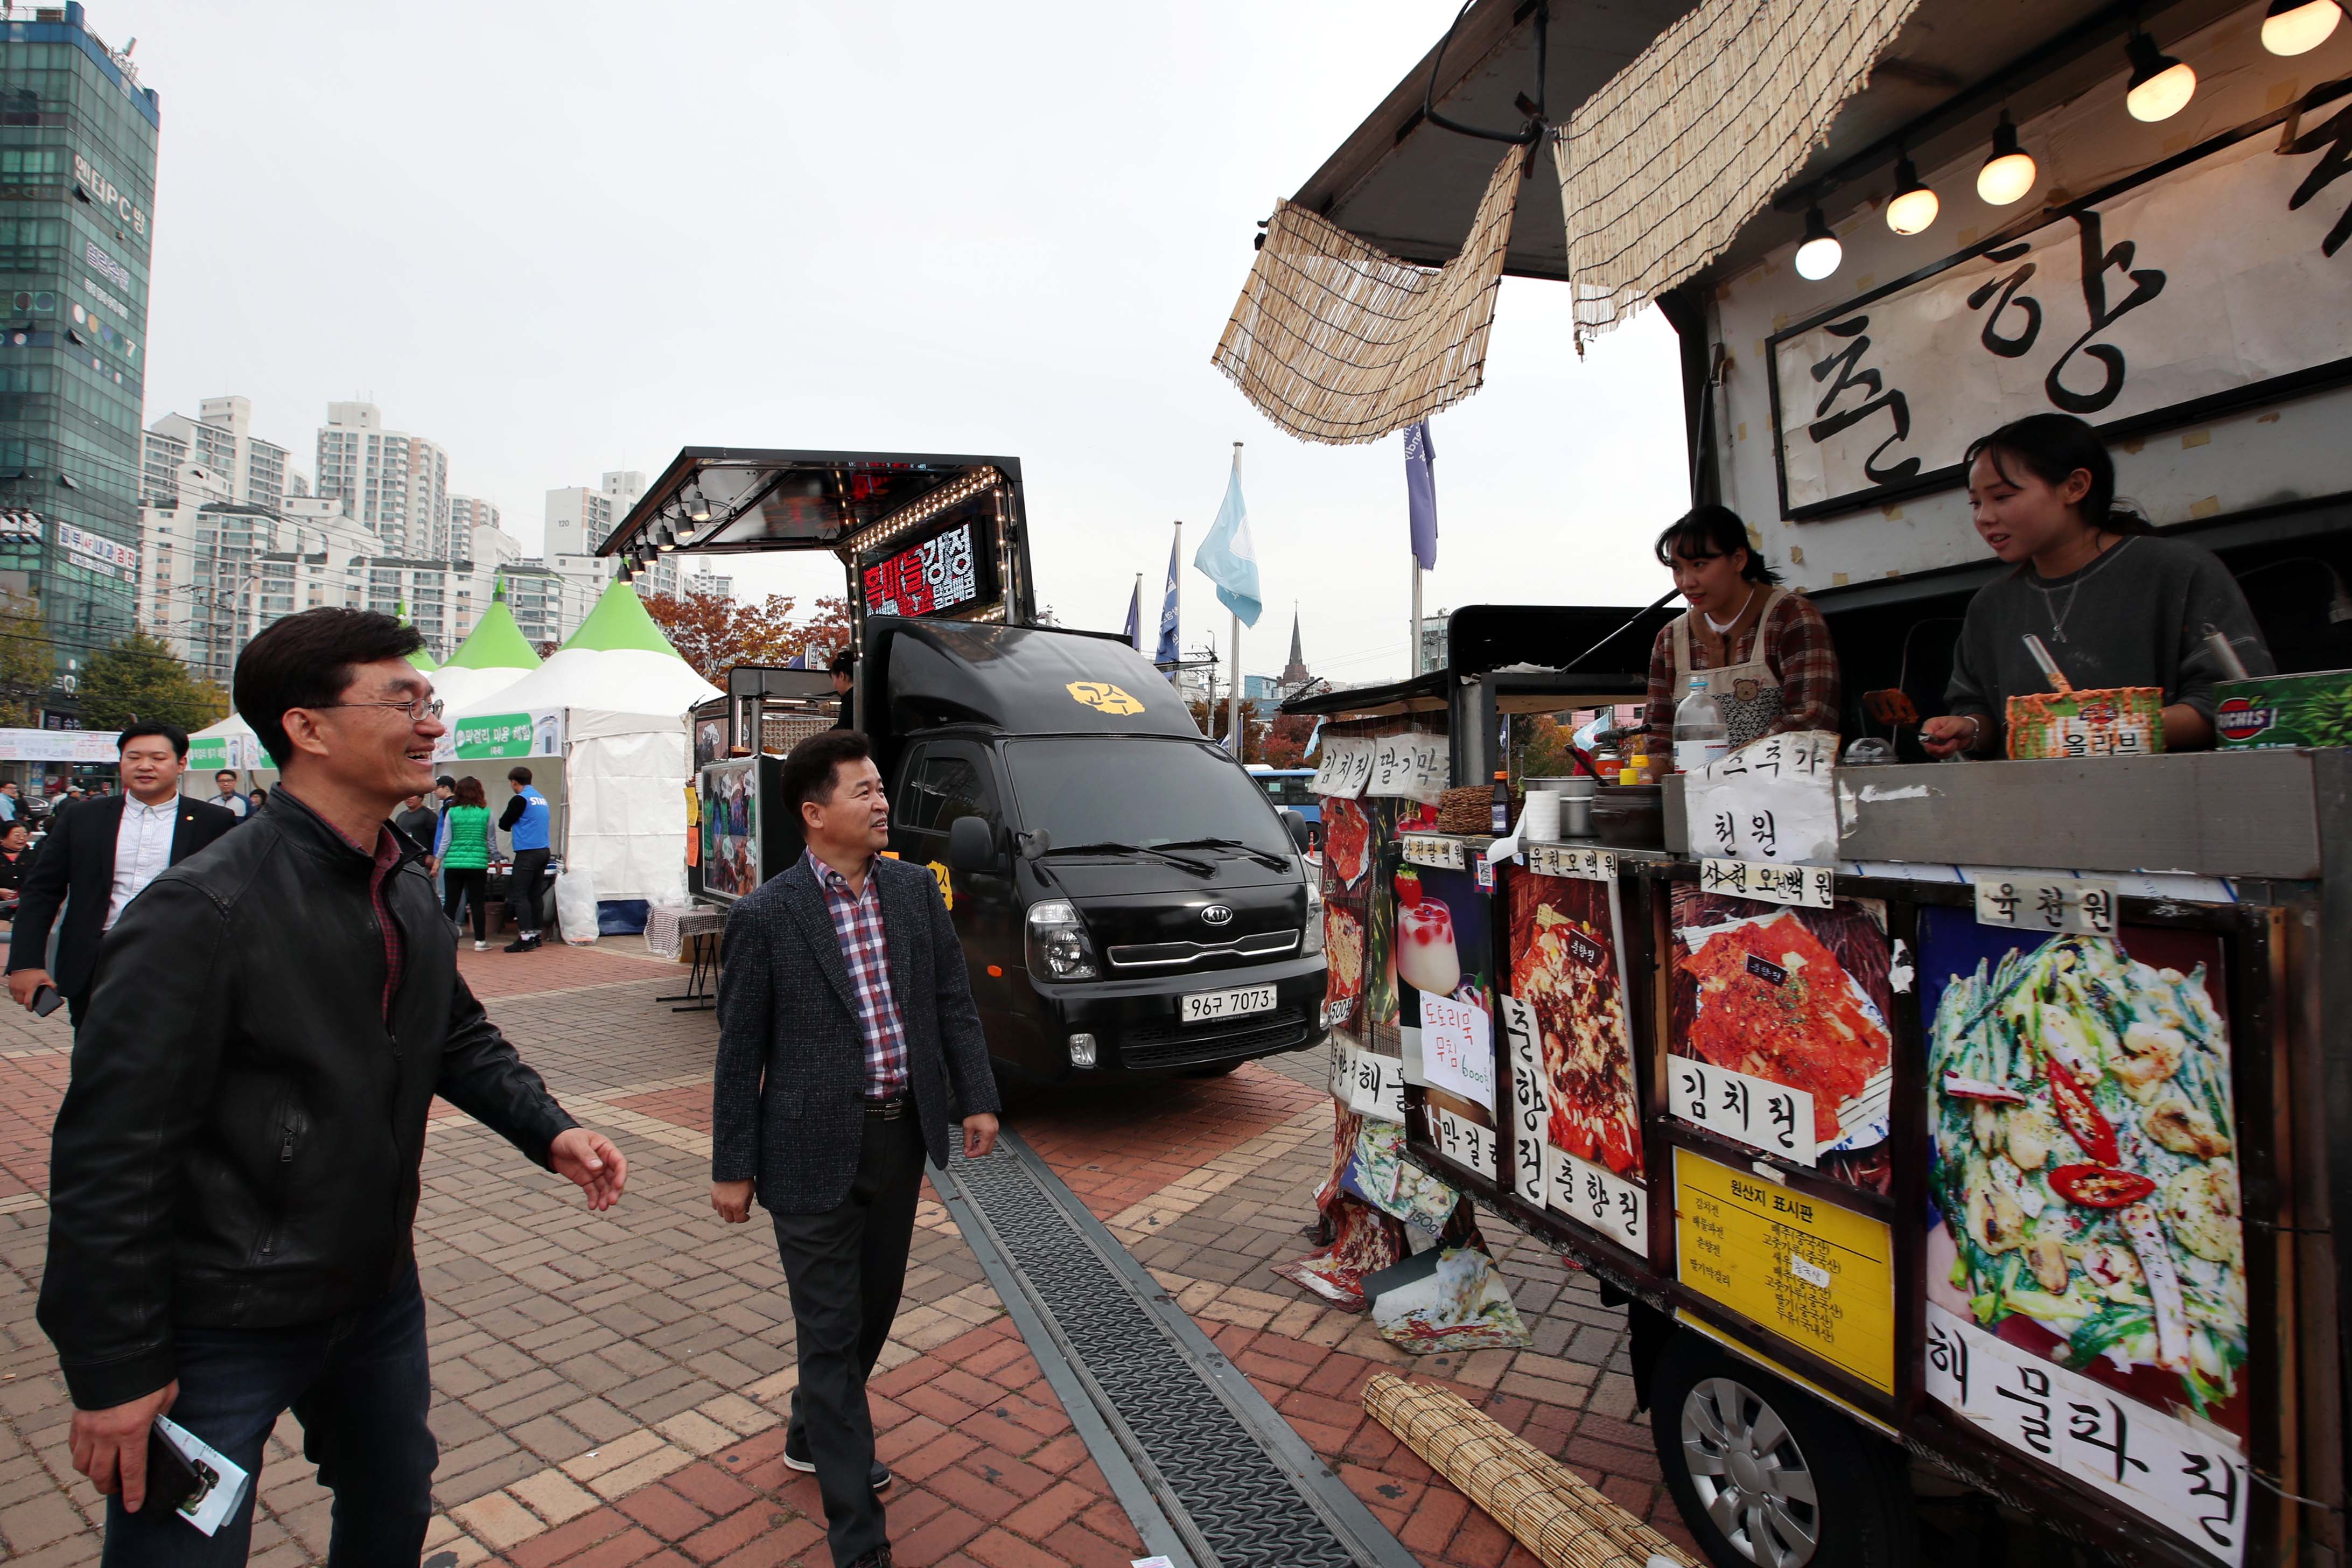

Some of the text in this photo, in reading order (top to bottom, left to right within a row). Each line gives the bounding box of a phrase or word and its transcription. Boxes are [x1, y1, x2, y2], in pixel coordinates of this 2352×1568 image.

[1380, 746, 1450, 789] 딸기막
[1715, 810, 1776, 856] 천원
[1530, 848, 1617, 878] 육천오백원
[1994, 883, 2111, 932] 육천원
[1192, 990, 1269, 1017] 96구 7073
[1436, 1037, 1457, 1067] 무침
[1508, 1000, 1547, 1199] 춘향전
[1682, 1068, 1795, 1148] 김치전
[1555, 1158, 1638, 1236] 춘향전
[1695, 1198, 1719, 1217] 김치전
[1731, 1180, 1813, 1223] 원산지 표시판
[1408, 1208, 1439, 1235] 150g
